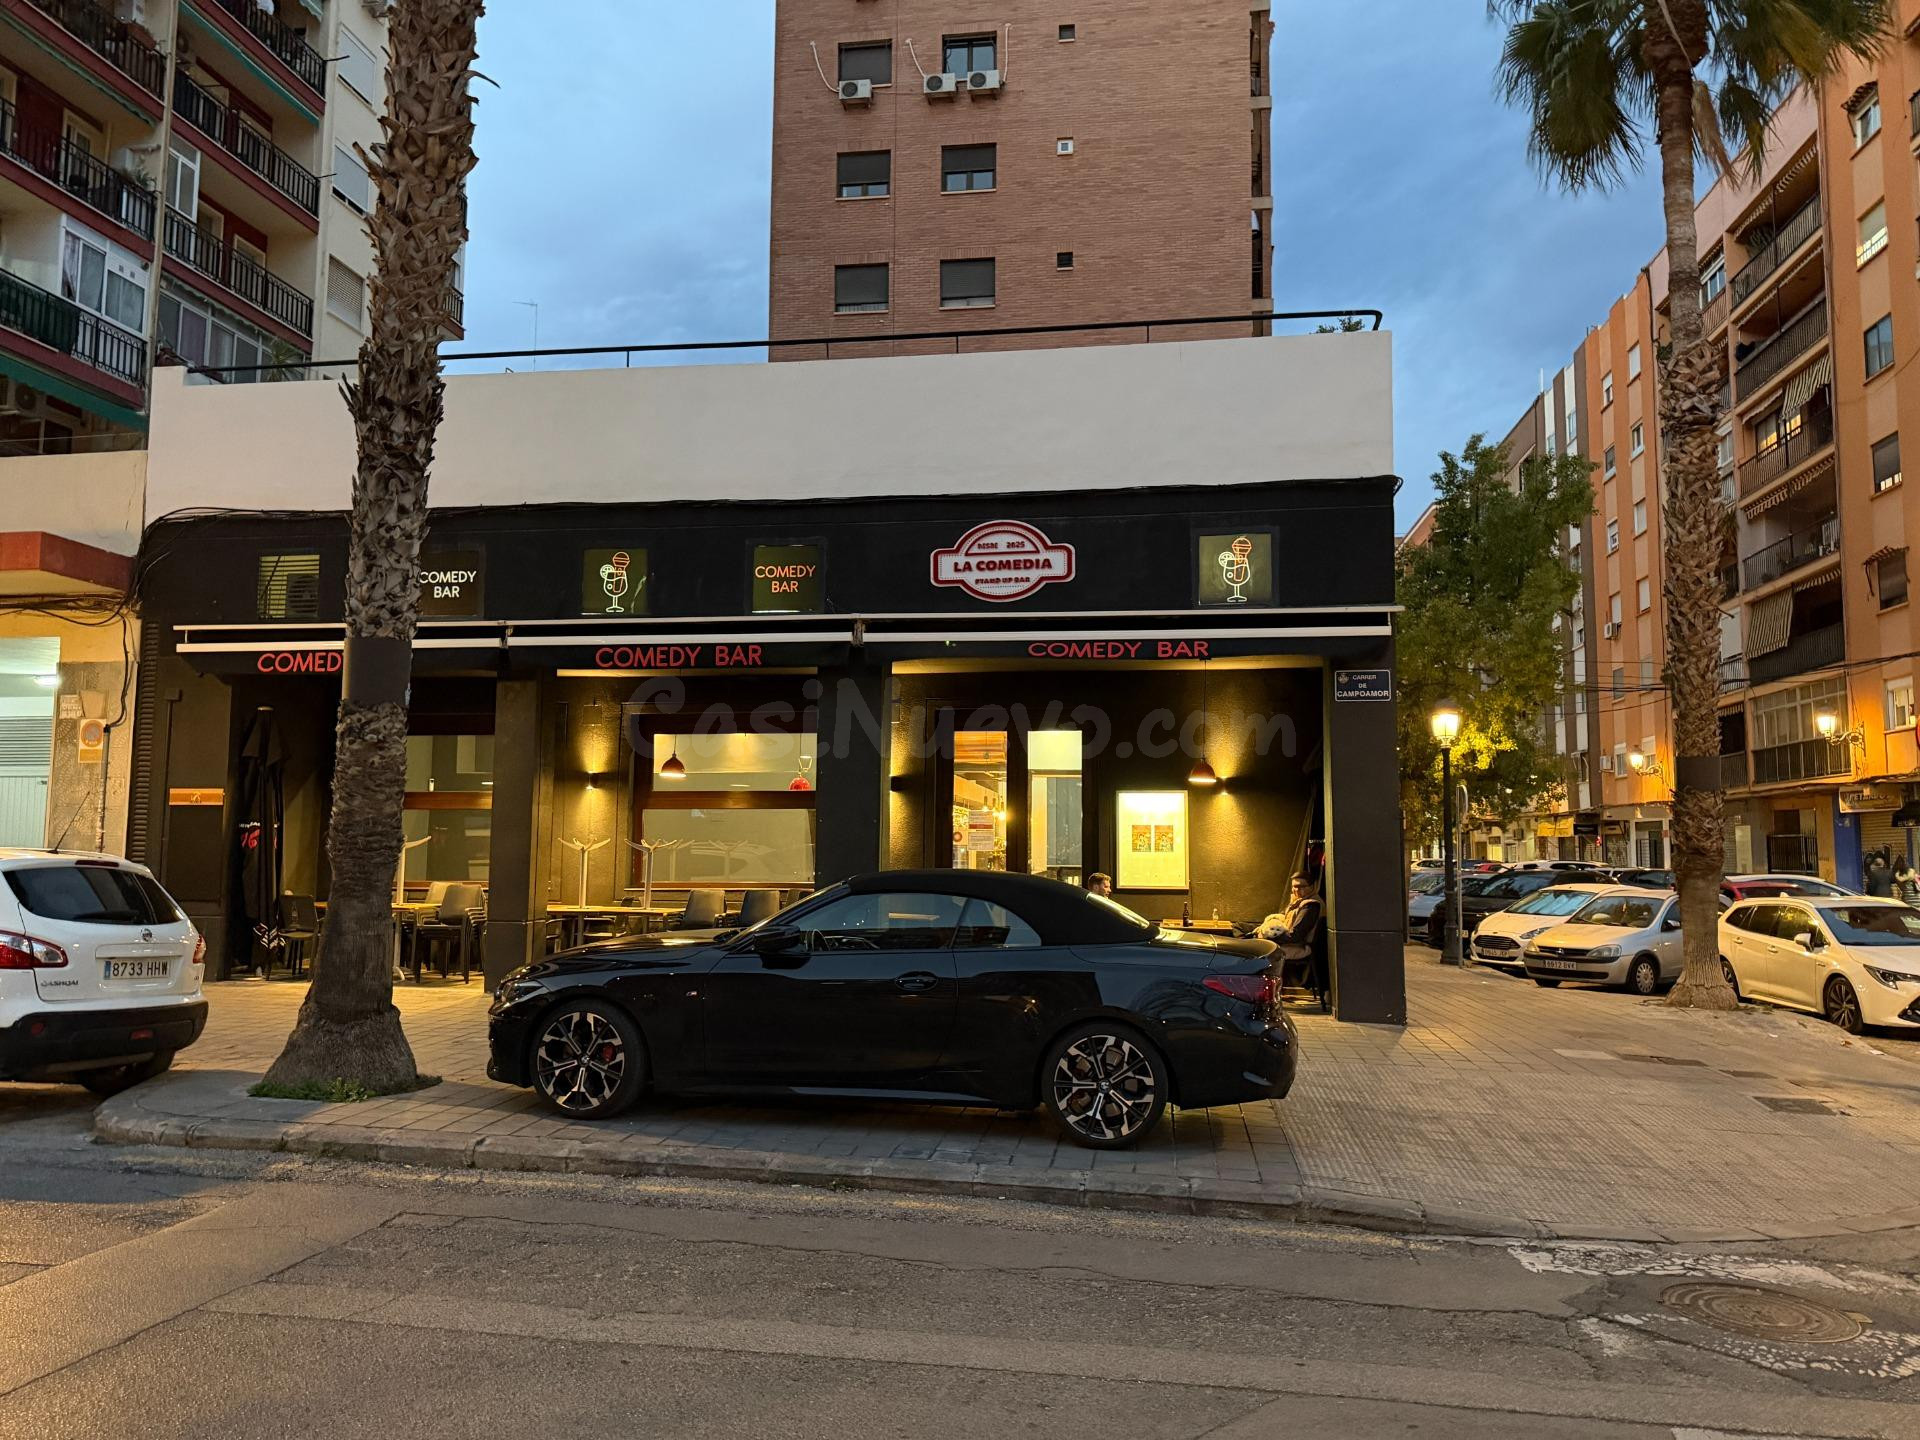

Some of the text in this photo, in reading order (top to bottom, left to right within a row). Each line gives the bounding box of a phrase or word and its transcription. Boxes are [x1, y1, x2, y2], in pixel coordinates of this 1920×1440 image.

[754, 565, 816, 579] COMEDY
[953, 558, 1053, 573] LA COMEDIA
[420, 570, 477, 584] COMEDY
[975, 577, 1001, 585] STAND
[433, 585, 460, 599] BAR
[771, 580, 799, 594] BAR
[1027, 640, 1210, 659] COMEDY BAR
[257, 652, 345, 673] COMED
[595, 645, 763, 669] COMEDY BAR
[112, 961, 169, 977] 8733 HHW
